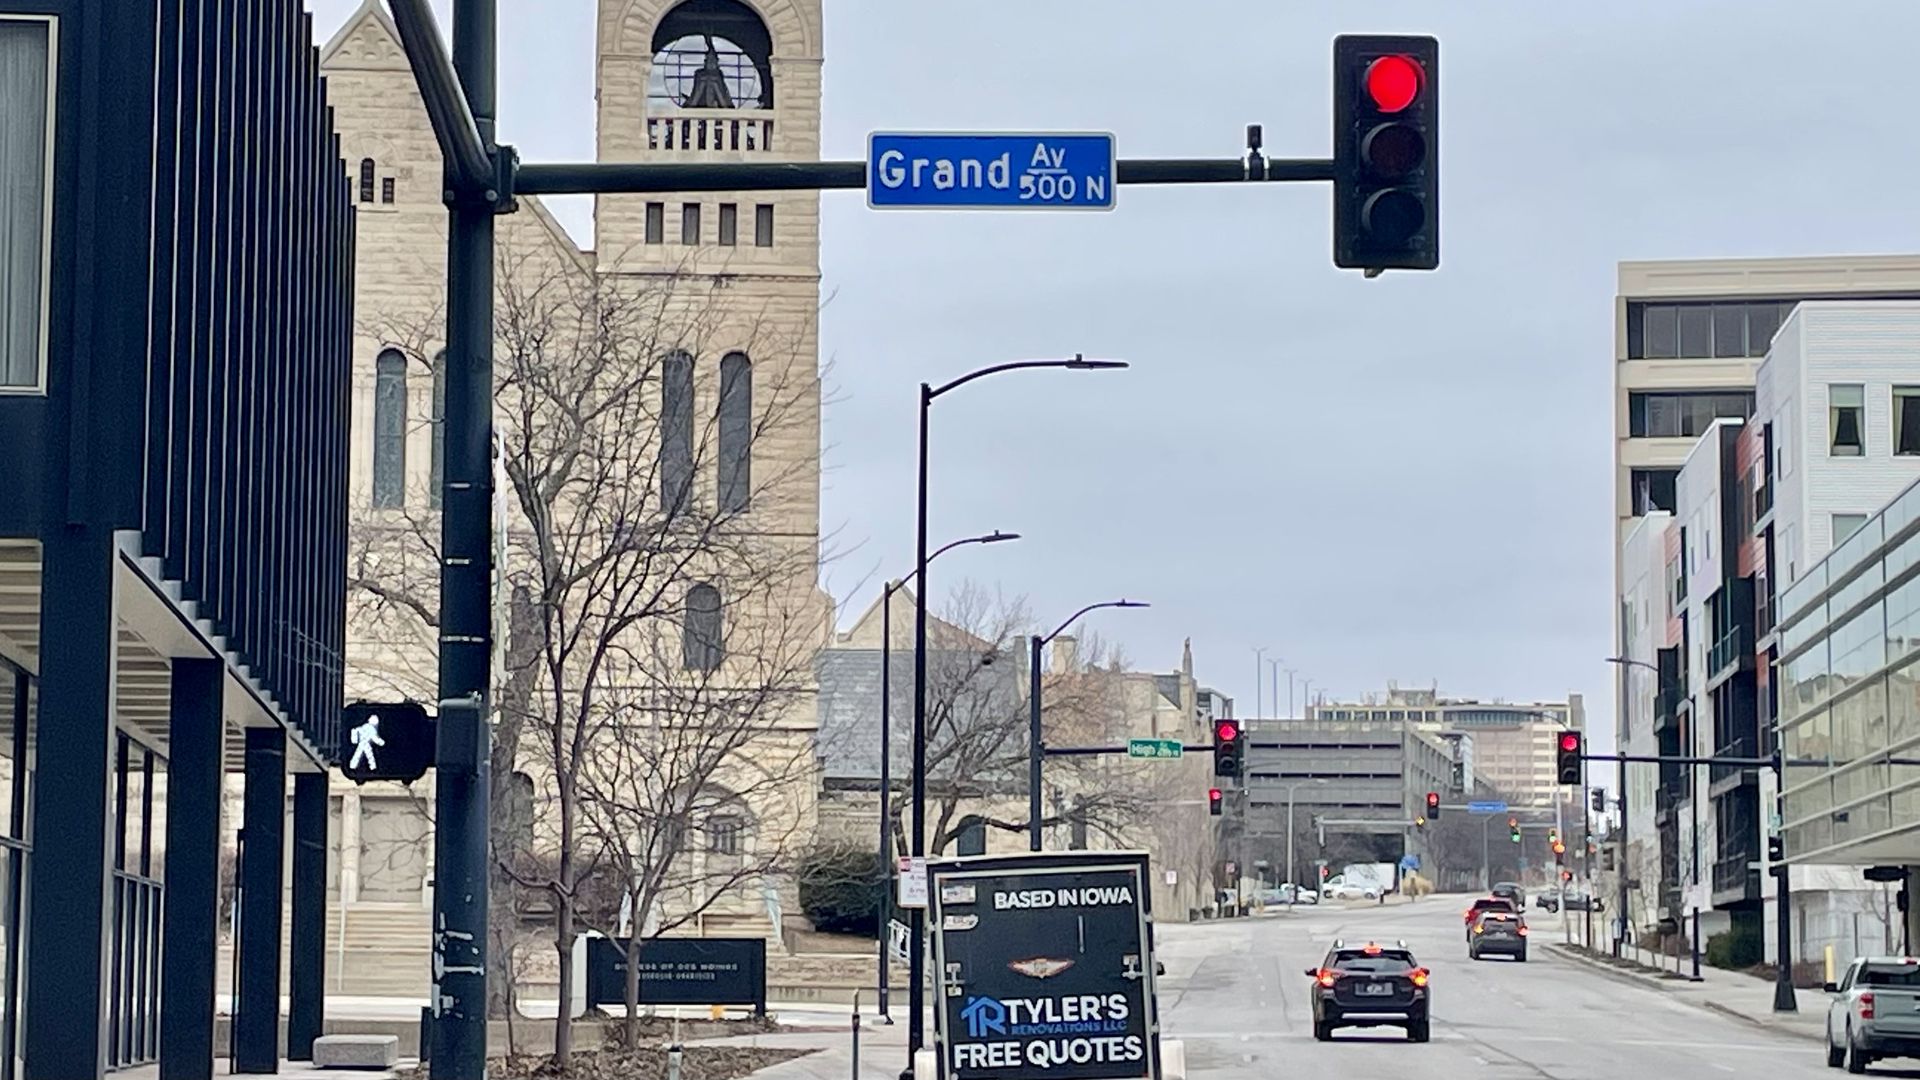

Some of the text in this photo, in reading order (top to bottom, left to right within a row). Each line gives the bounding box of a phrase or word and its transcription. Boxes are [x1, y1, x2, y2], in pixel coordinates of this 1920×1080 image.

[878, 142, 1066, 190] Grand Av
[1019, 175, 1105, 200] 500 N
[994, 890, 1056, 910] BASED
[1057, 888, 1078, 907] IN
[1080, 886, 1133, 906] IOWA
[1000, 993, 1130, 1025] TYLER'S
[1011, 1020, 1128, 1036] RENOVATIONS LLC
[953, 1035, 1143, 1069] FREE QUOTES
